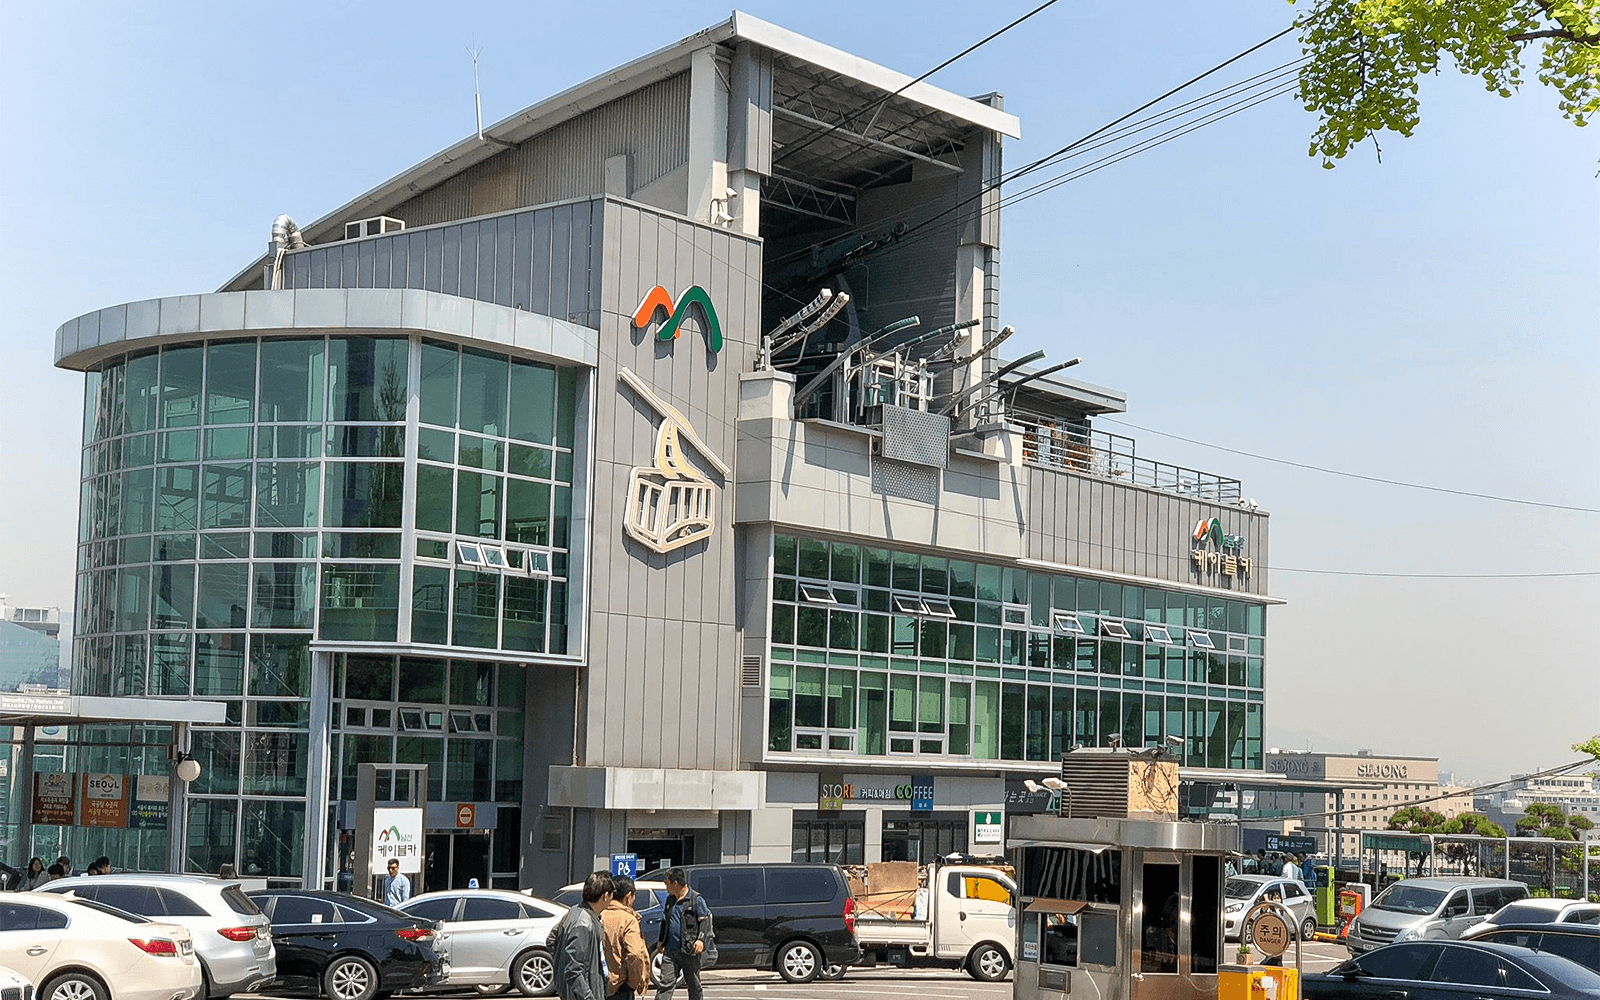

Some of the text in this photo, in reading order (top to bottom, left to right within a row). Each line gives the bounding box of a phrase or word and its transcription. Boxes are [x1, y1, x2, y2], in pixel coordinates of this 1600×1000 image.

[1190, 549, 1253, 579] 케이블카
[1270, 758, 1309, 773] SEJONG
[1357, 763, 1408, 779] SEJONG
[89, 779, 119, 789] SEOUL
[822, 783, 854, 799] STORE
[895, 784, 933, 800] COFFEE
[377, 844, 417, 857] 케이블카
[617, 861, 624, 875] P
[1260, 924, 1282, 938] 주의
[1259, 936, 1281, 945] DANGER
